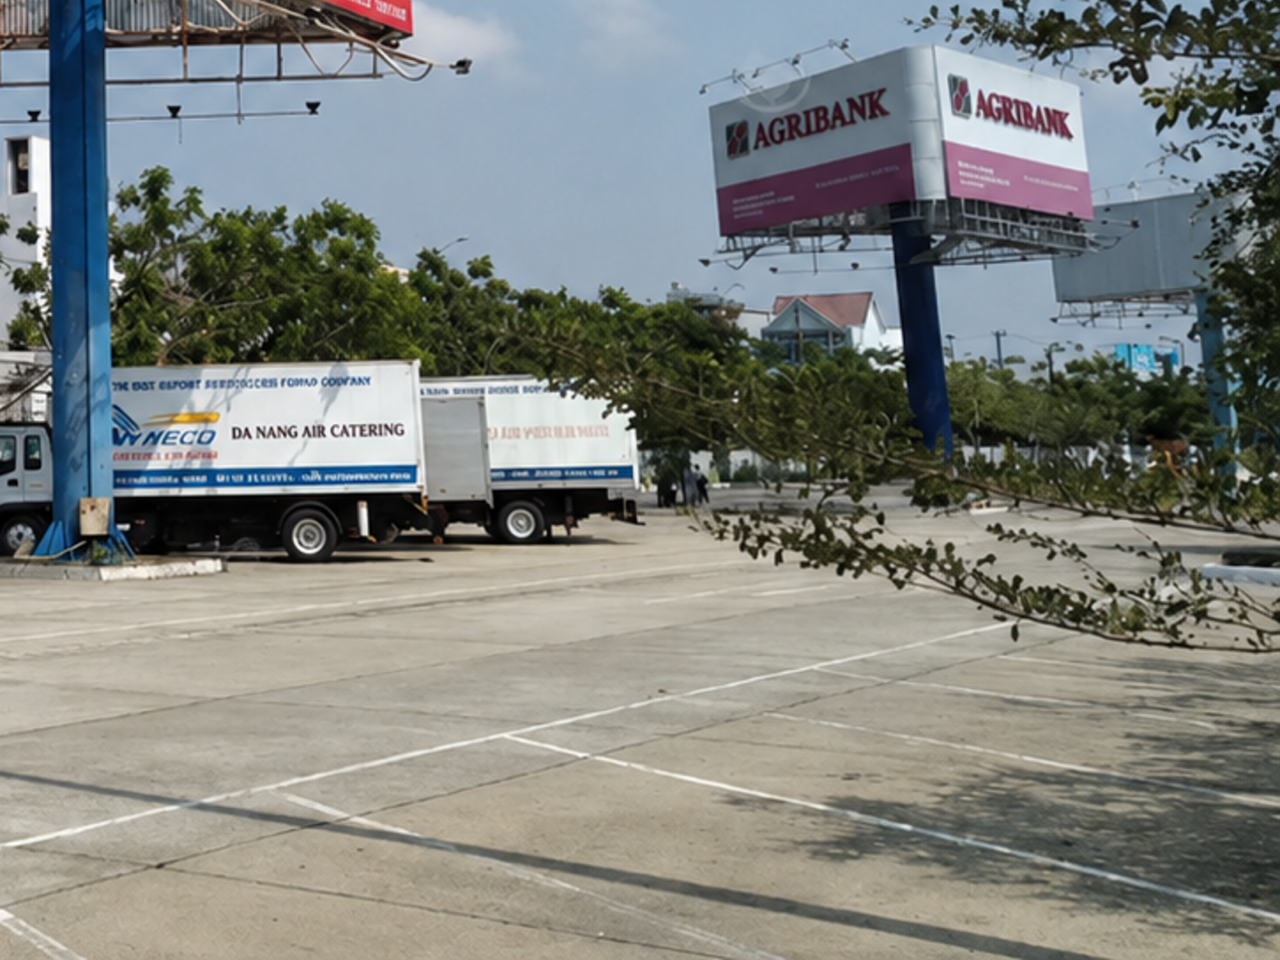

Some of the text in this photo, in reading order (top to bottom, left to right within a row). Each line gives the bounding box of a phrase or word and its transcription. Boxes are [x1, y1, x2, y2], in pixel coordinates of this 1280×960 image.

[753, 88, 890, 150] AGRIBANK
[975, 89, 1074, 140] AGRIBANK
[232, 423, 405, 440] DA NANG AIR CATERING
